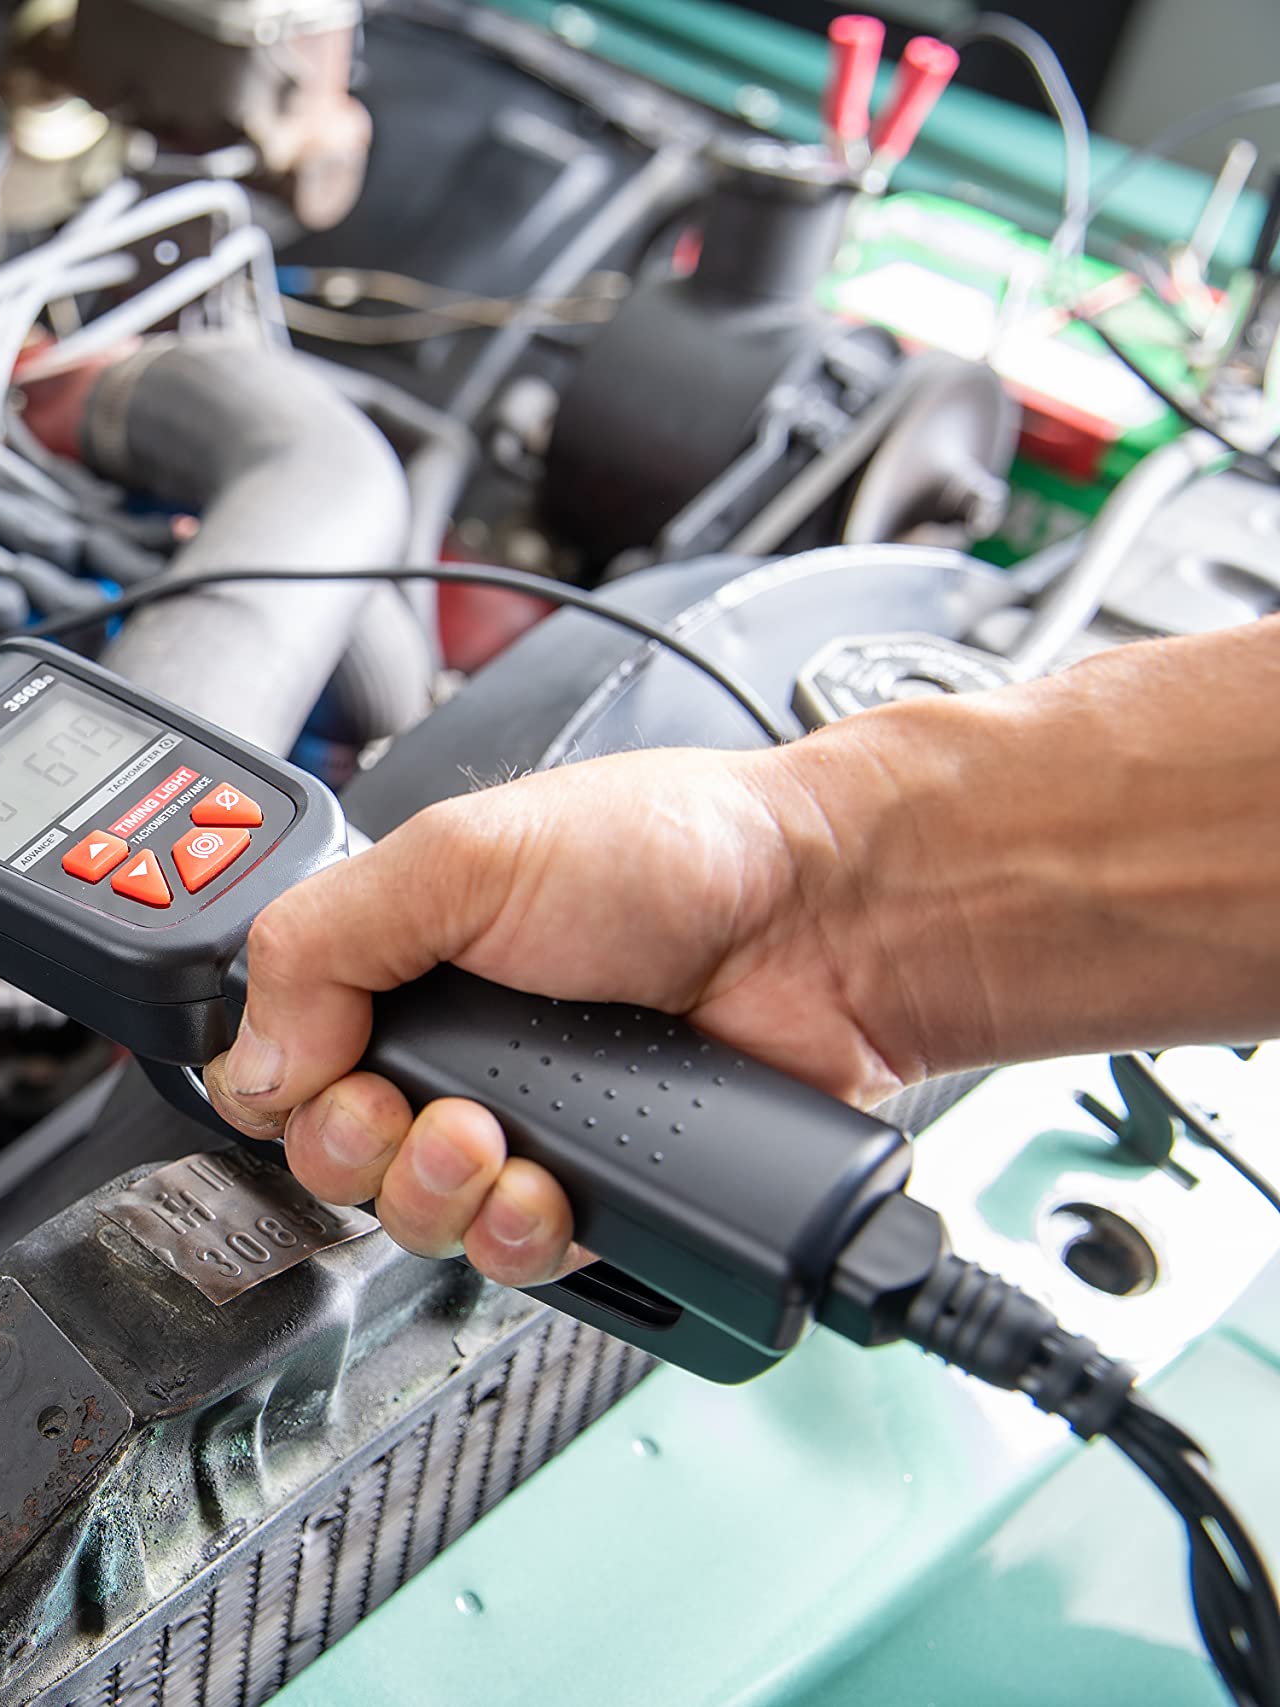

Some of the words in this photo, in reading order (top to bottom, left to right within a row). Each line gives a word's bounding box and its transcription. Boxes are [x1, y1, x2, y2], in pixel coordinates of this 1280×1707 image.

[107, 749, 161, 794] TACHOMETER
[114, 797, 160, 834] TIMING
[155, 769, 193, 800] LIGHT
[130, 804, 181, 846] TACHOMETER
[179, 775, 213, 807] ADVANCE
